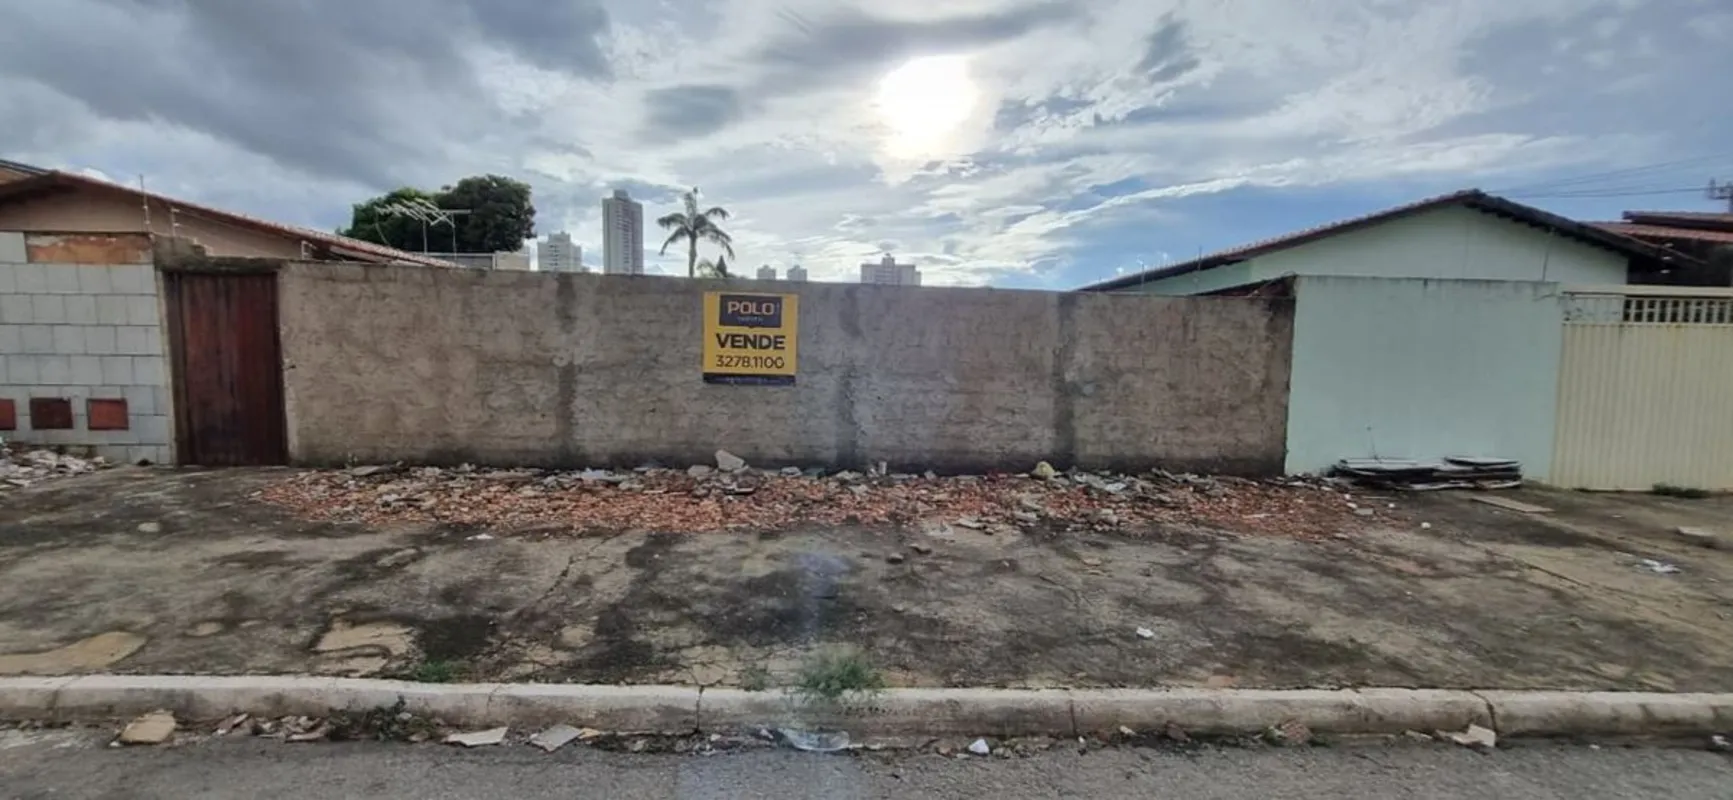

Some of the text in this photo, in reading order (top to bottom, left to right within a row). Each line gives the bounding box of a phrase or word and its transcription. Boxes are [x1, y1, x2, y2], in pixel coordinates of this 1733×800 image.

[727, 301, 774, 315] POLO
[716, 333, 786, 350] VENDE
[716, 355, 785, 369] 3278.1100
